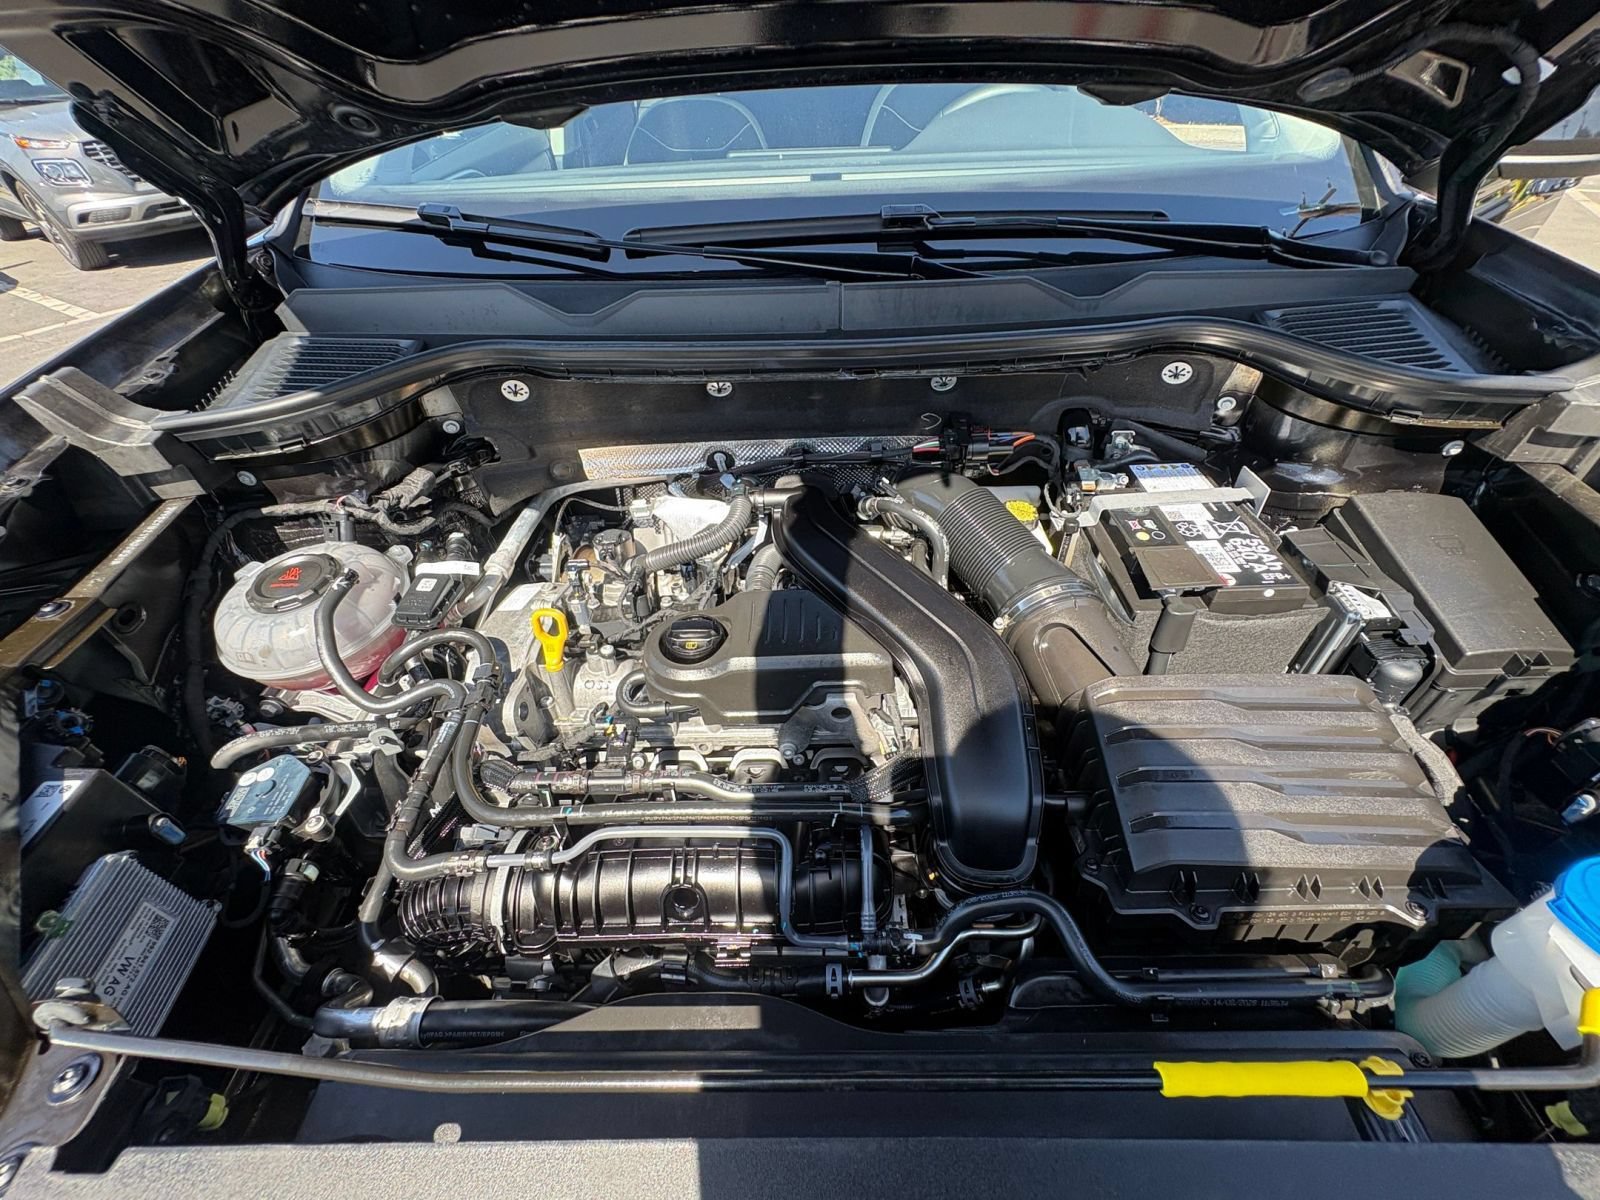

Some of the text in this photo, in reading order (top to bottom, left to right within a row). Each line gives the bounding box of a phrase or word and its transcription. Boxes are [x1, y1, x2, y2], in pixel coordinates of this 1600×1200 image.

[1229, 538, 1259, 560] 640
[1248, 562, 1269, 573] A
[1246, 538, 1284, 571] 59Ah
[103, 956, 135, 997] VW AG
